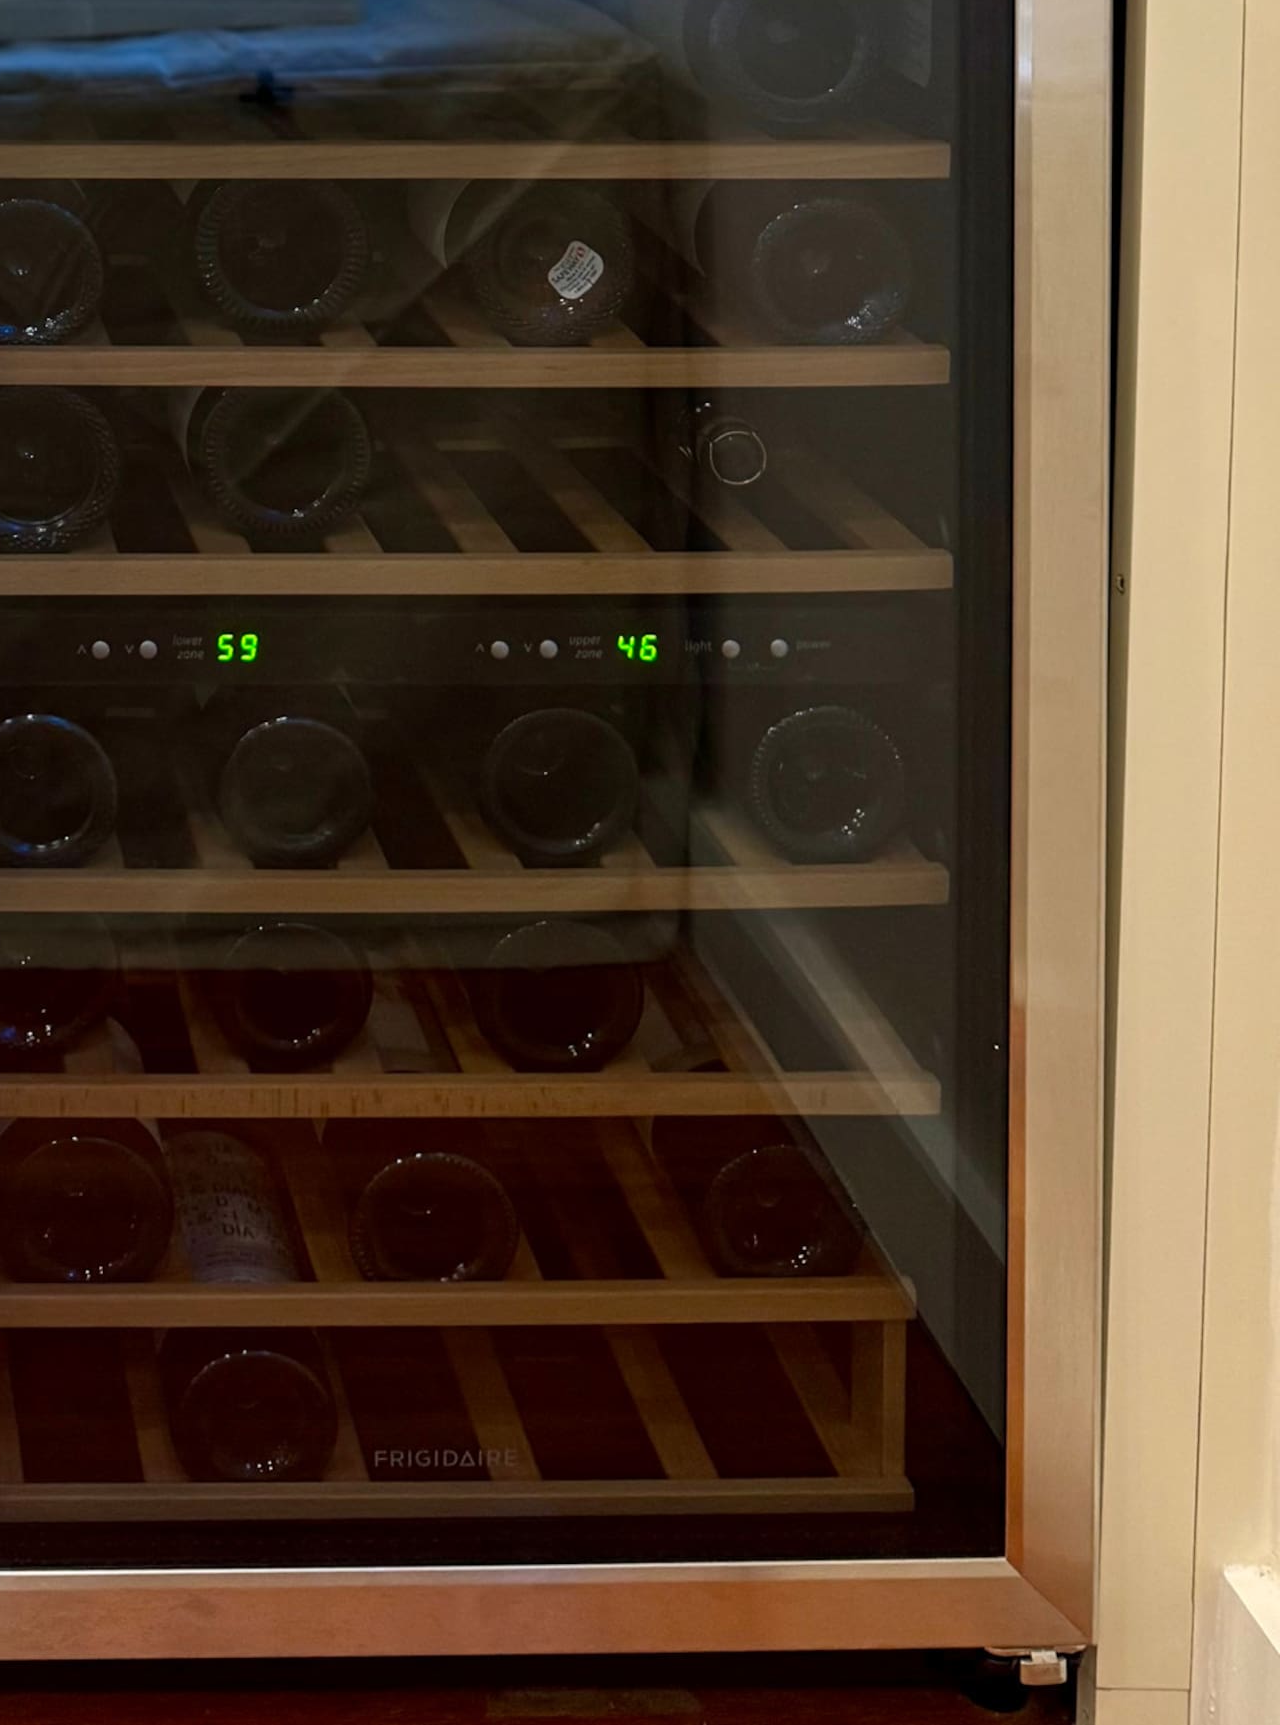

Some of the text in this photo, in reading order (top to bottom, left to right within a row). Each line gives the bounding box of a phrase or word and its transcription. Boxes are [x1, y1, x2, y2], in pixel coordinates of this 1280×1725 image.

[172, 634, 203, 647] lower
[217, 633, 259, 661] 59
[569, 635, 601, 649] upper
[616, 633, 658, 662] 46
[684, 640, 713, 655] light
[176, 650, 205, 661] zone
[574, 649, 603, 660] zone
[374, 1448, 518, 1469] FRIGIDAIRE
